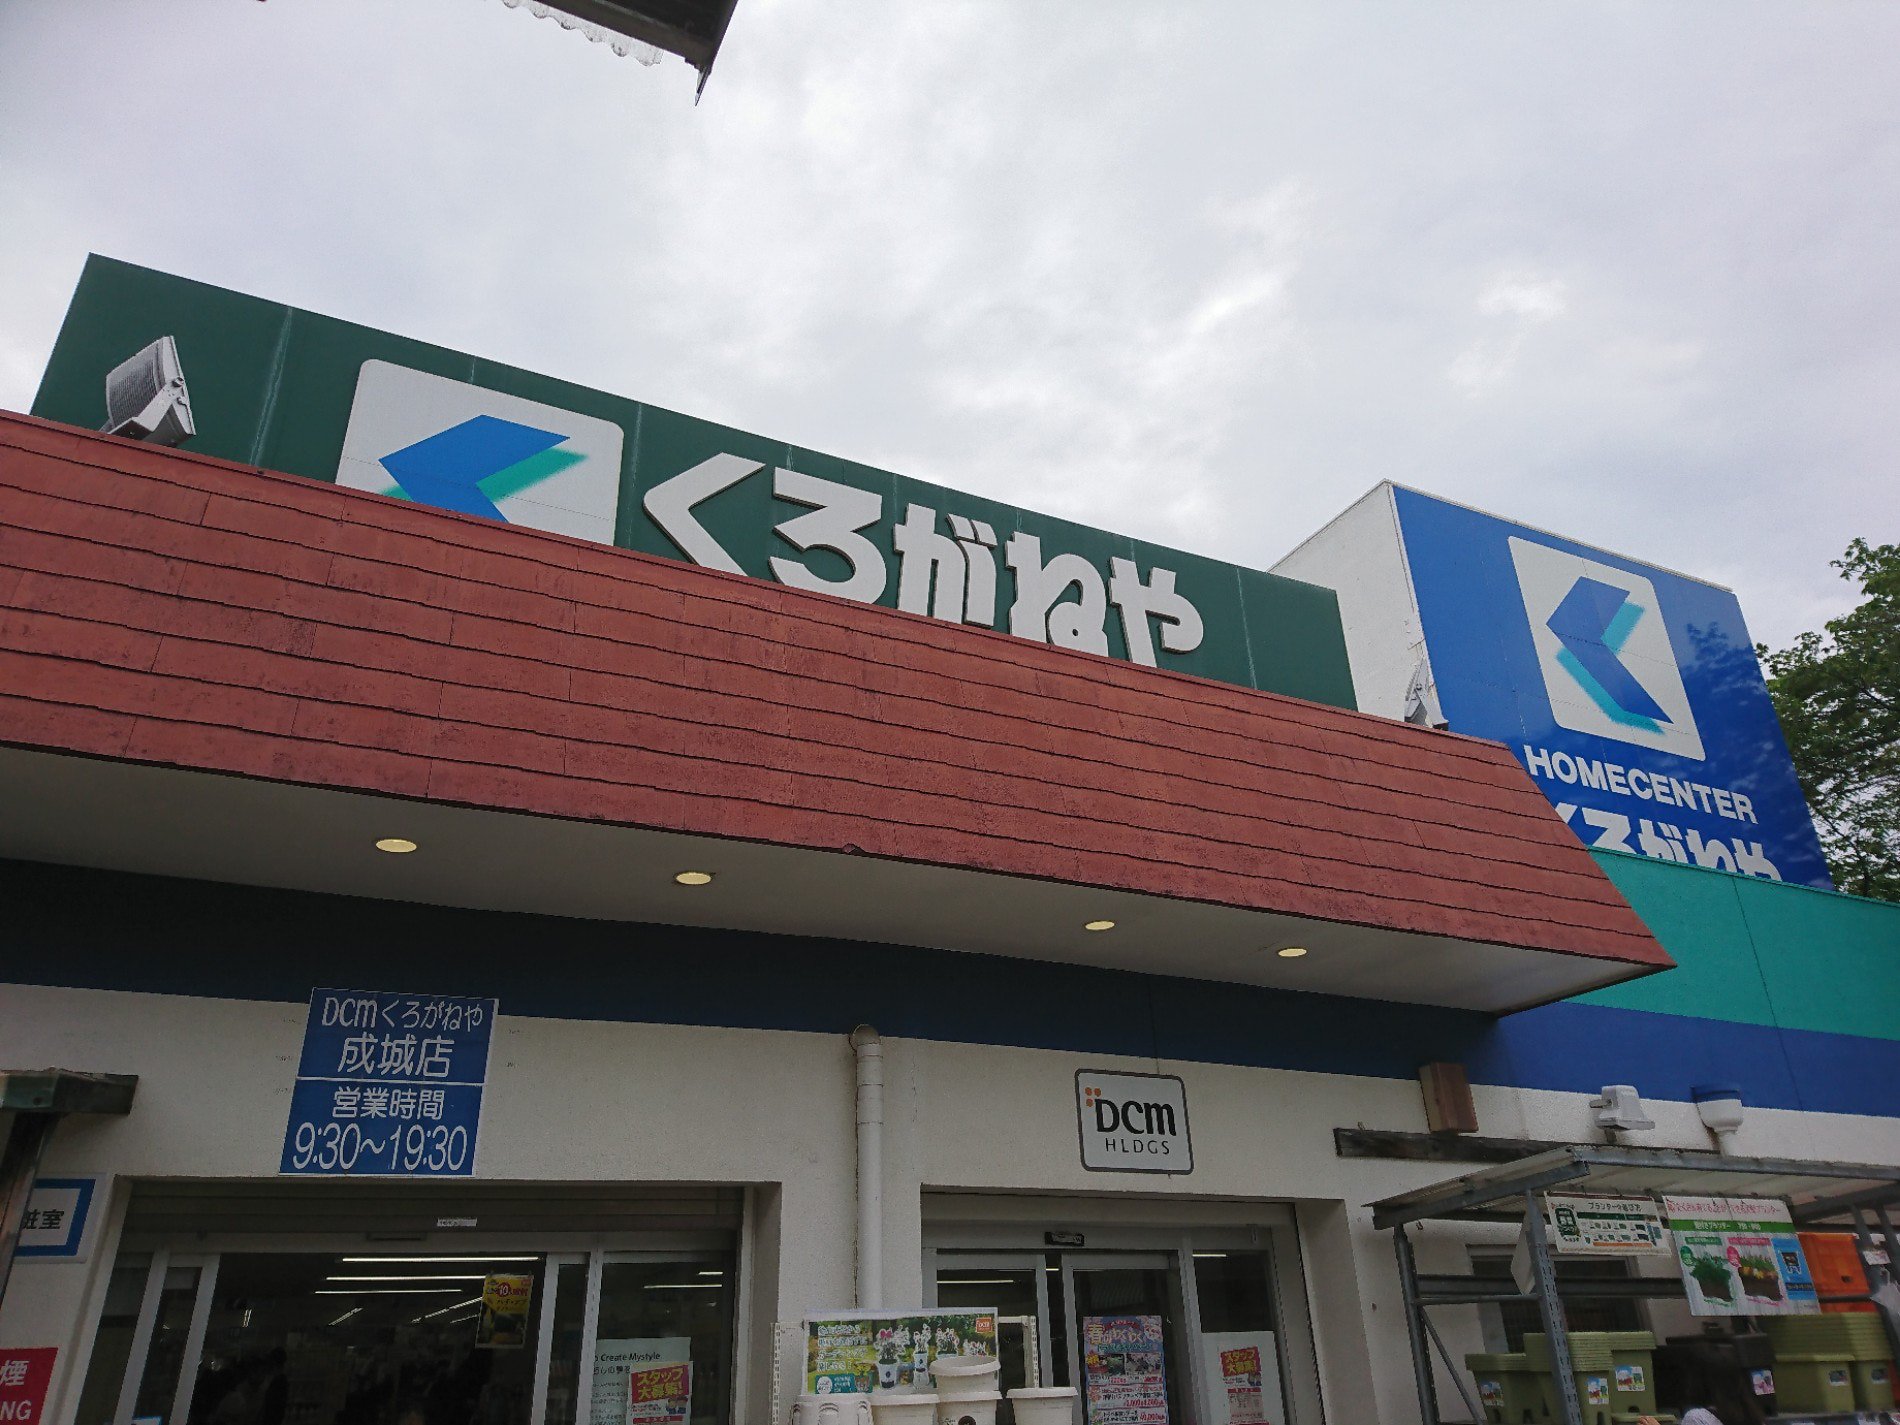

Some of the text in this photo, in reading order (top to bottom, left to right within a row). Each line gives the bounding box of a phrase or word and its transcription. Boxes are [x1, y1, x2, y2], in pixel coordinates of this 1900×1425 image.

[643, 452, 1204, 669] くろがねや
[1523, 744, 1759, 825] HOMECENTER
[337, 1032, 455, 1078] 成城店
[332, 1086, 445, 1120] 営業時間
[1105, 1138, 1170, 1155] HLDGS
[600, 1353, 627, 1362] Create
[629, 1351, 661, 1362] Mystyle
[637, 1367, 684, 1386] スタッフ
[0, 1400, 32, 1421] NG
